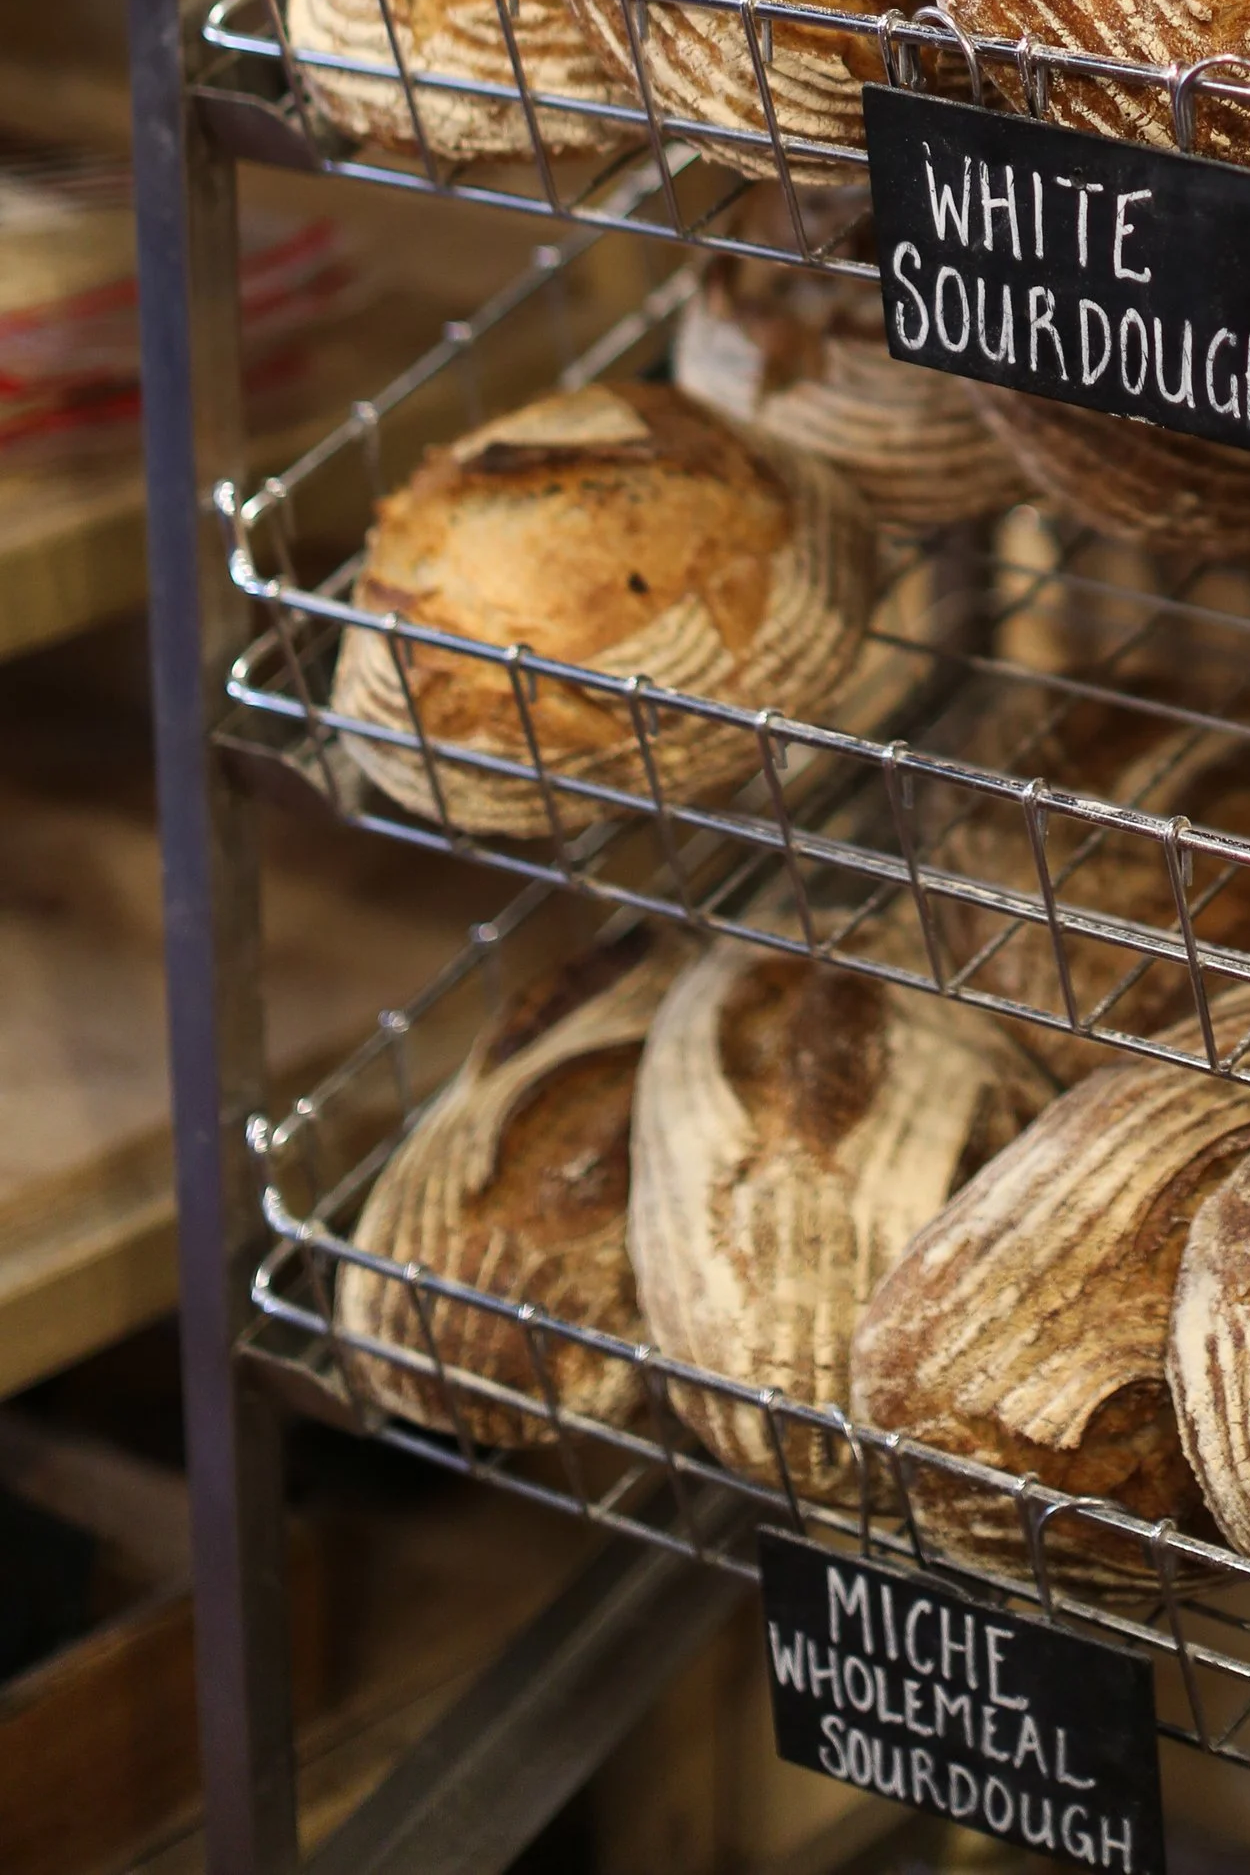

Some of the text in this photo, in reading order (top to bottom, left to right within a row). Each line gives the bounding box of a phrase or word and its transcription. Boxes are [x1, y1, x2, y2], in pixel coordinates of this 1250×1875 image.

[922, 140, 1152, 283] WHITE
[768, 1621, 1097, 1790] WHOLEMEAL
[825, 1565, 1029, 1711] MICHE
[818, 1714, 1134, 1874] SOURDOUGH
